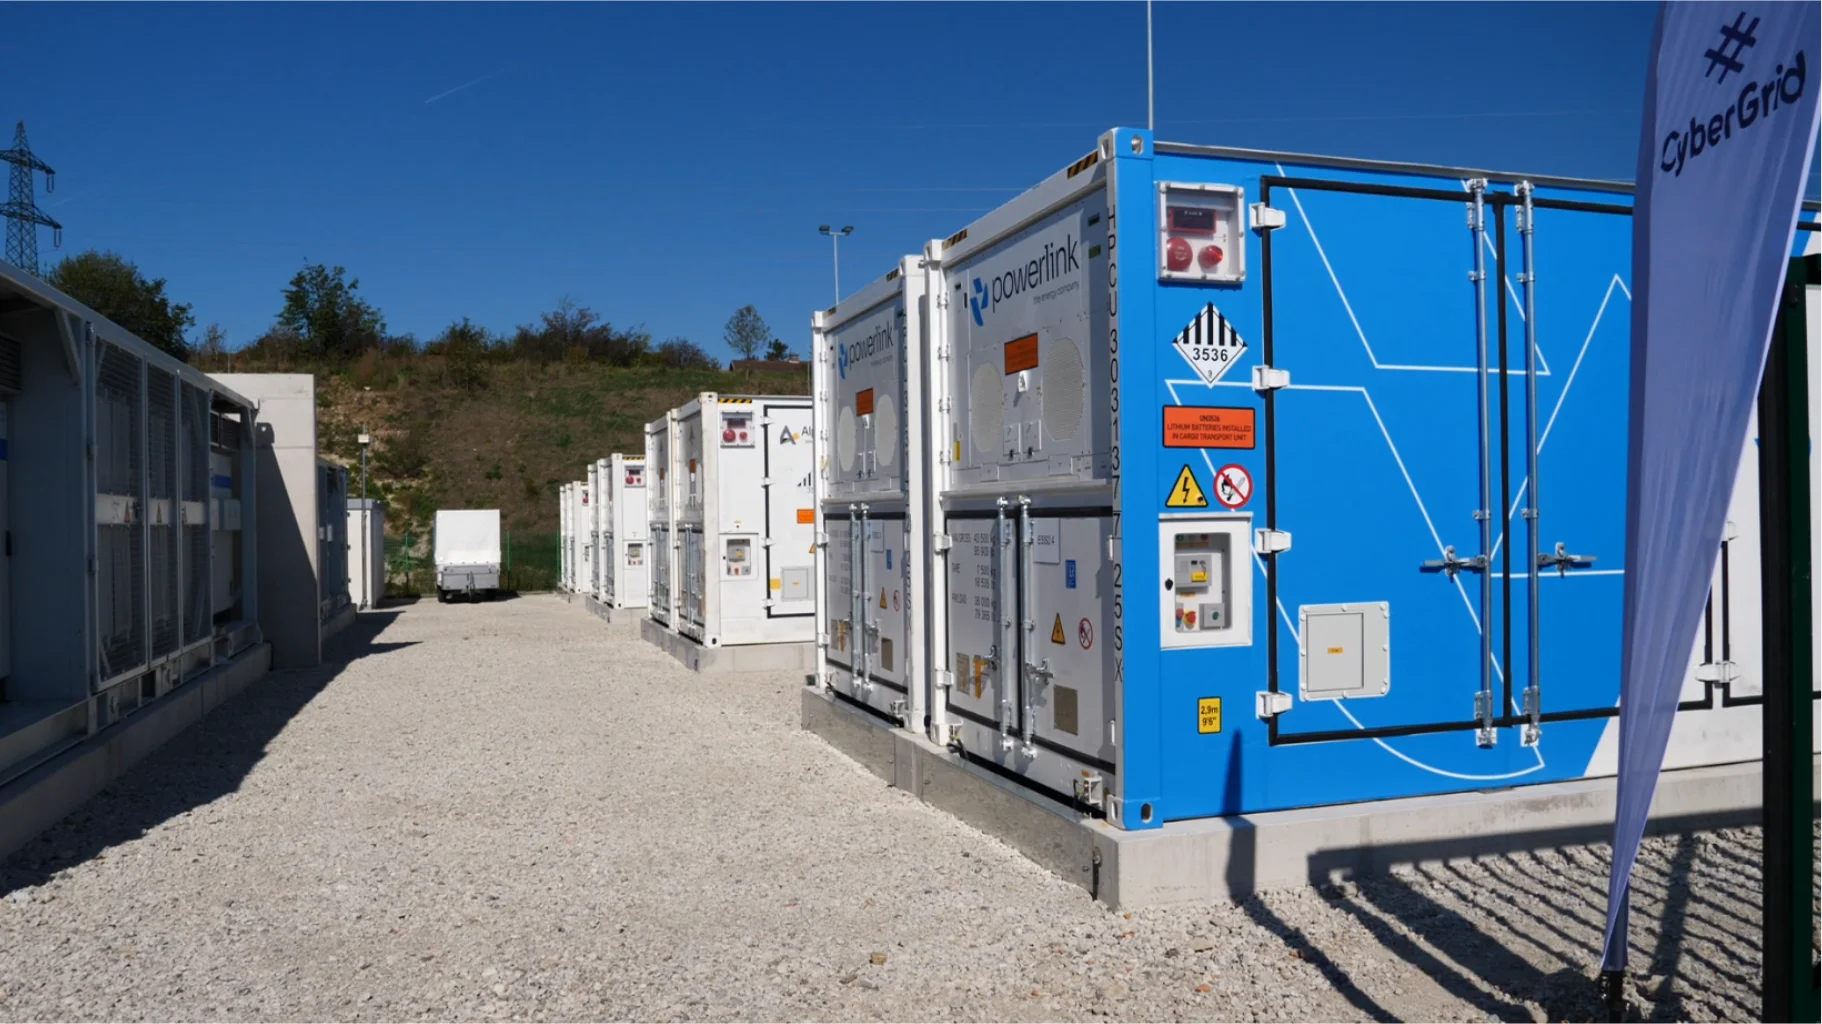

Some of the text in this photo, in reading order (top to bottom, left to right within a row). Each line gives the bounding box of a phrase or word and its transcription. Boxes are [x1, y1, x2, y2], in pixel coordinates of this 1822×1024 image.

[1661, 50, 1806, 178] CyberGrid
[992, 234, 1080, 313] powerlink
[849, 321, 894, 370] powerlink
[1193, 347, 1228, 362] 3536
[1167, 423, 1190, 431] LITHIUM
[1172, 432, 1179, 440] IN
